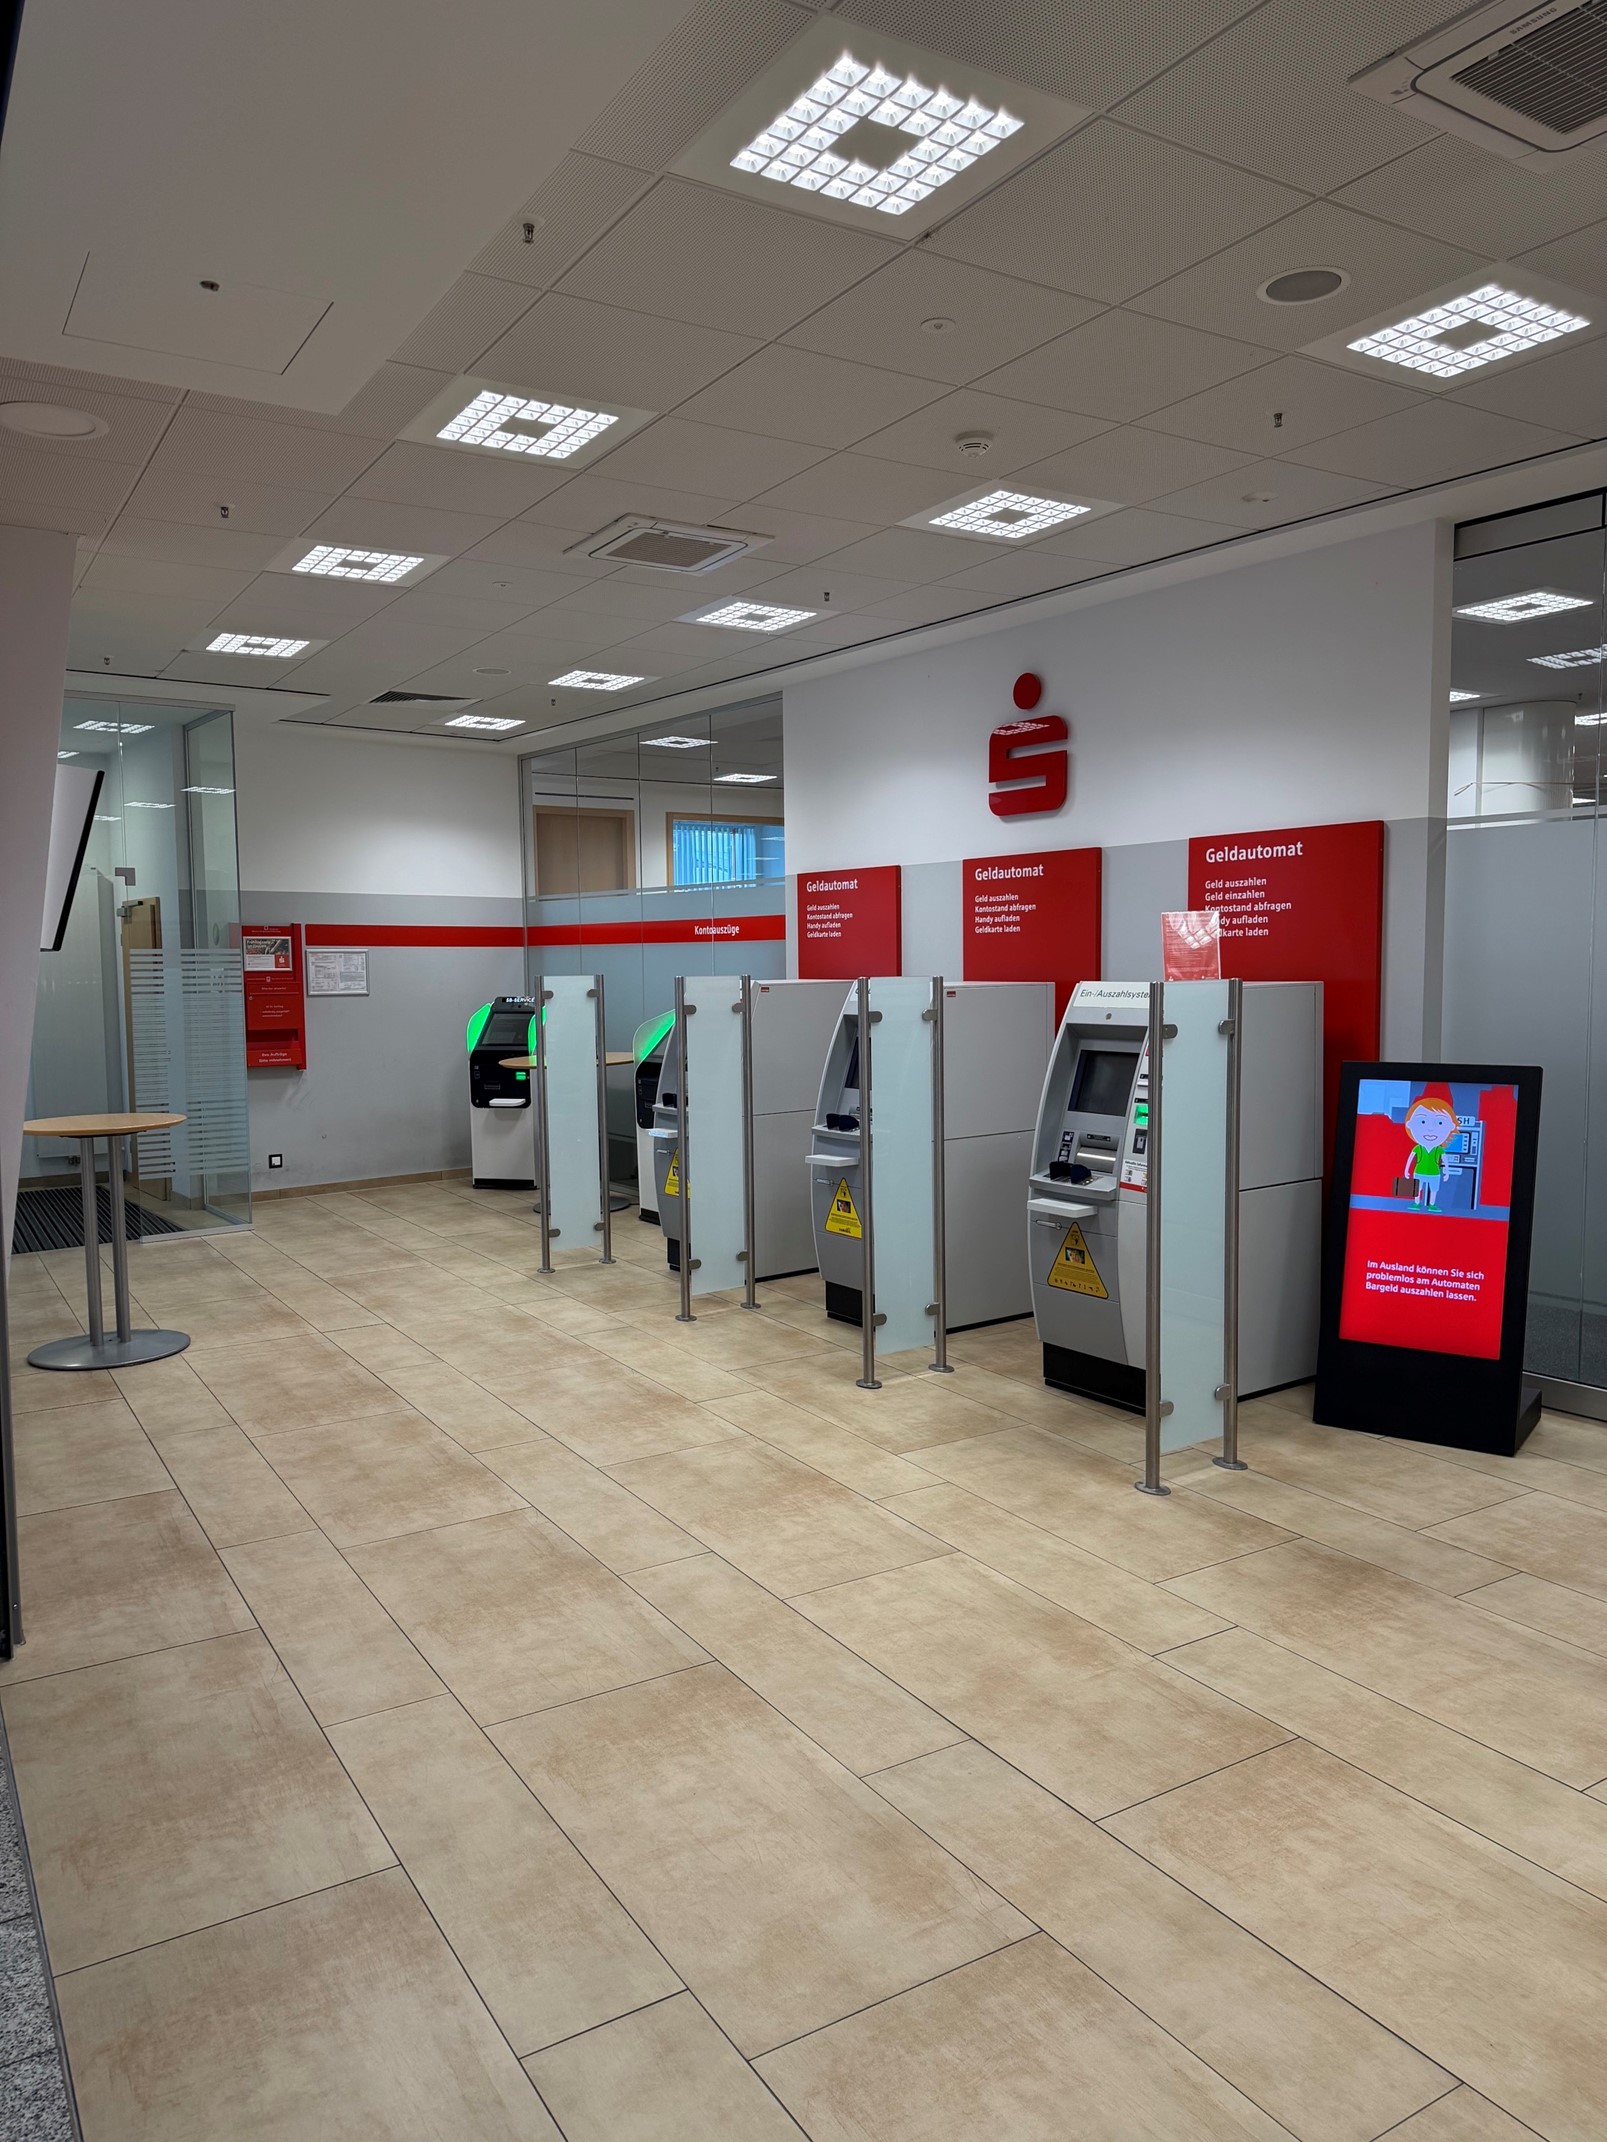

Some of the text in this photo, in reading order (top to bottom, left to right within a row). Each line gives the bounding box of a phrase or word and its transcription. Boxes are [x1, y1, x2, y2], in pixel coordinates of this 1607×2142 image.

[1205, 841, 1303, 863] Geldautomat
[975, 864, 1044, 881] Geldautomat
[807, 879, 859, 893] Geldautomat
[1205, 877, 1267, 889] Geld auszahlen
[975, 893, 1019, 903] Geld auszahlen
[1205, 890, 1265, 901] Geld einzahlen
[807, 903, 840, 912] Geld auszahlen
[975, 903, 1037, 913] Kontostand abfragen
[1204, 901, 1292, 913] Kontostand abfragen
[807, 912, 854, 921] Kontostand abfragen
[975, 914, 1020, 925] Handy aufladen
[1232, 914, 1269, 925] aufladen
[694, 924, 740, 937] Kontoauszüge
[807, 921, 842, 931] Handy aufladen
[975, 925, 1021, 934] Geldkarte laden
[807, 930, 842, 939] Geldkarte laden
[1245, 927, 1269, 937] laden
[1080, 989, 1150, 1000] Ein-/Auszahlsyste
[1367, 1260, 1485, 1280] Im Ausland können Sie sich
[1366, 1272, 1414, 1284] problemlos
[1431, 1278, 1481, 1291] Automaten
[1365, 1281, 1477, 1302] Bargeld auszahlen lassen.
